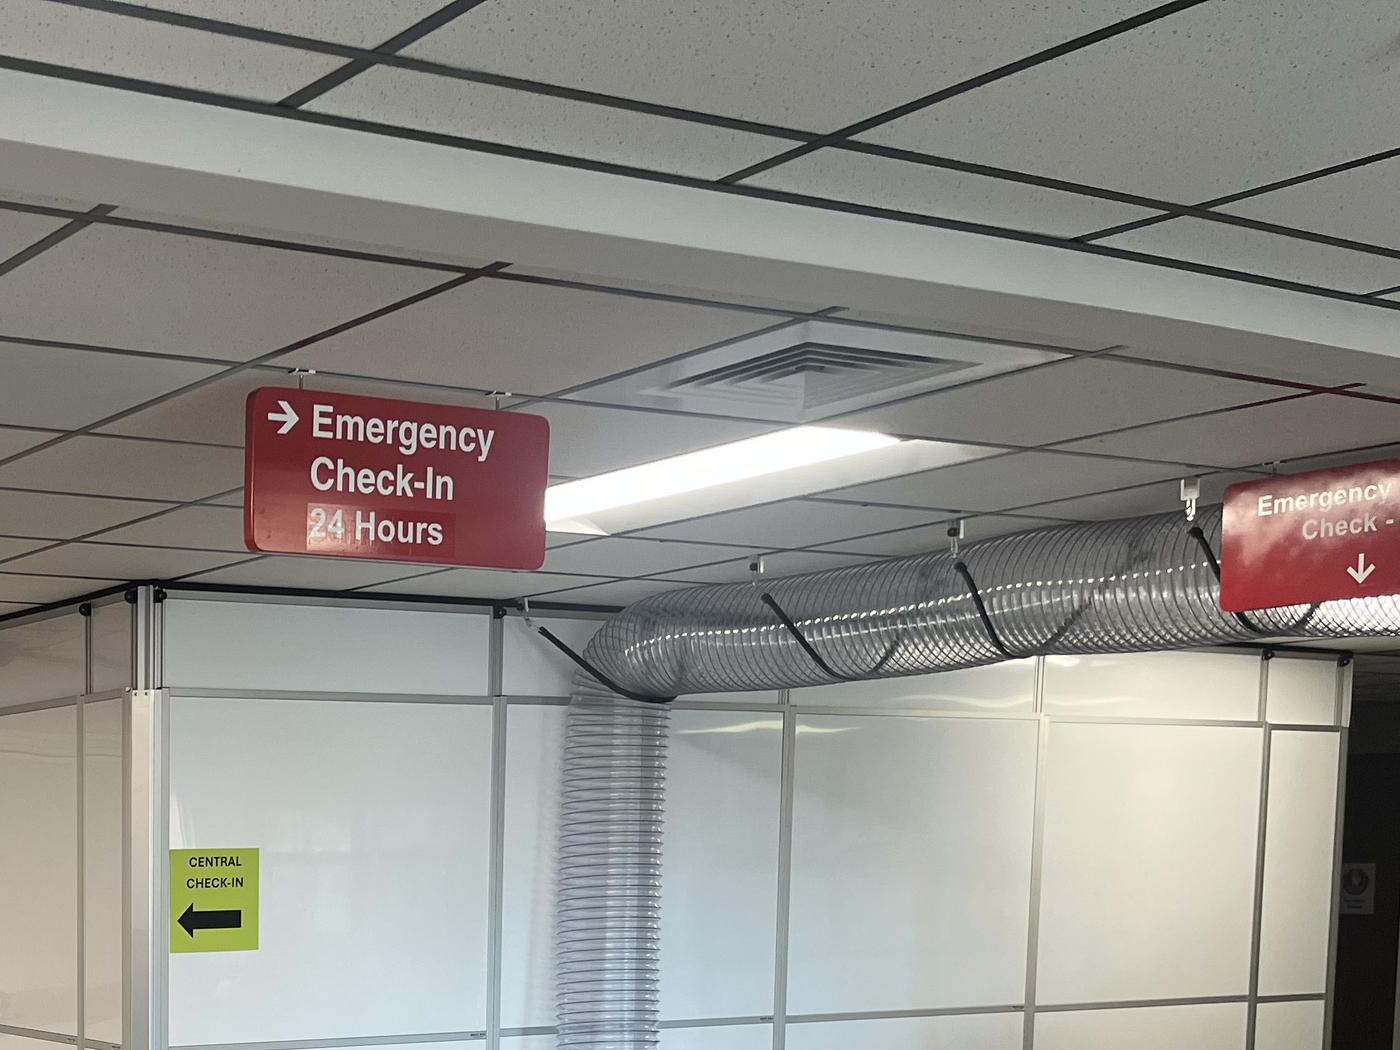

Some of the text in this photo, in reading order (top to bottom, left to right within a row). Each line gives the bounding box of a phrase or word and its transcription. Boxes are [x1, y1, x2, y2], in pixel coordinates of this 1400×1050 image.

[312, 404, 495, 462] Emergency
[310, 456, 454, 500] Check-In
[1257, 482, 1393, 516] Emergency
[309, 508, 443, 546] 24 Hours
[1302, 513, 1377, 540] Check
[189, 856, 242, 867] CENTRAL
[186, 877, 244, 889] CHECK-IN
